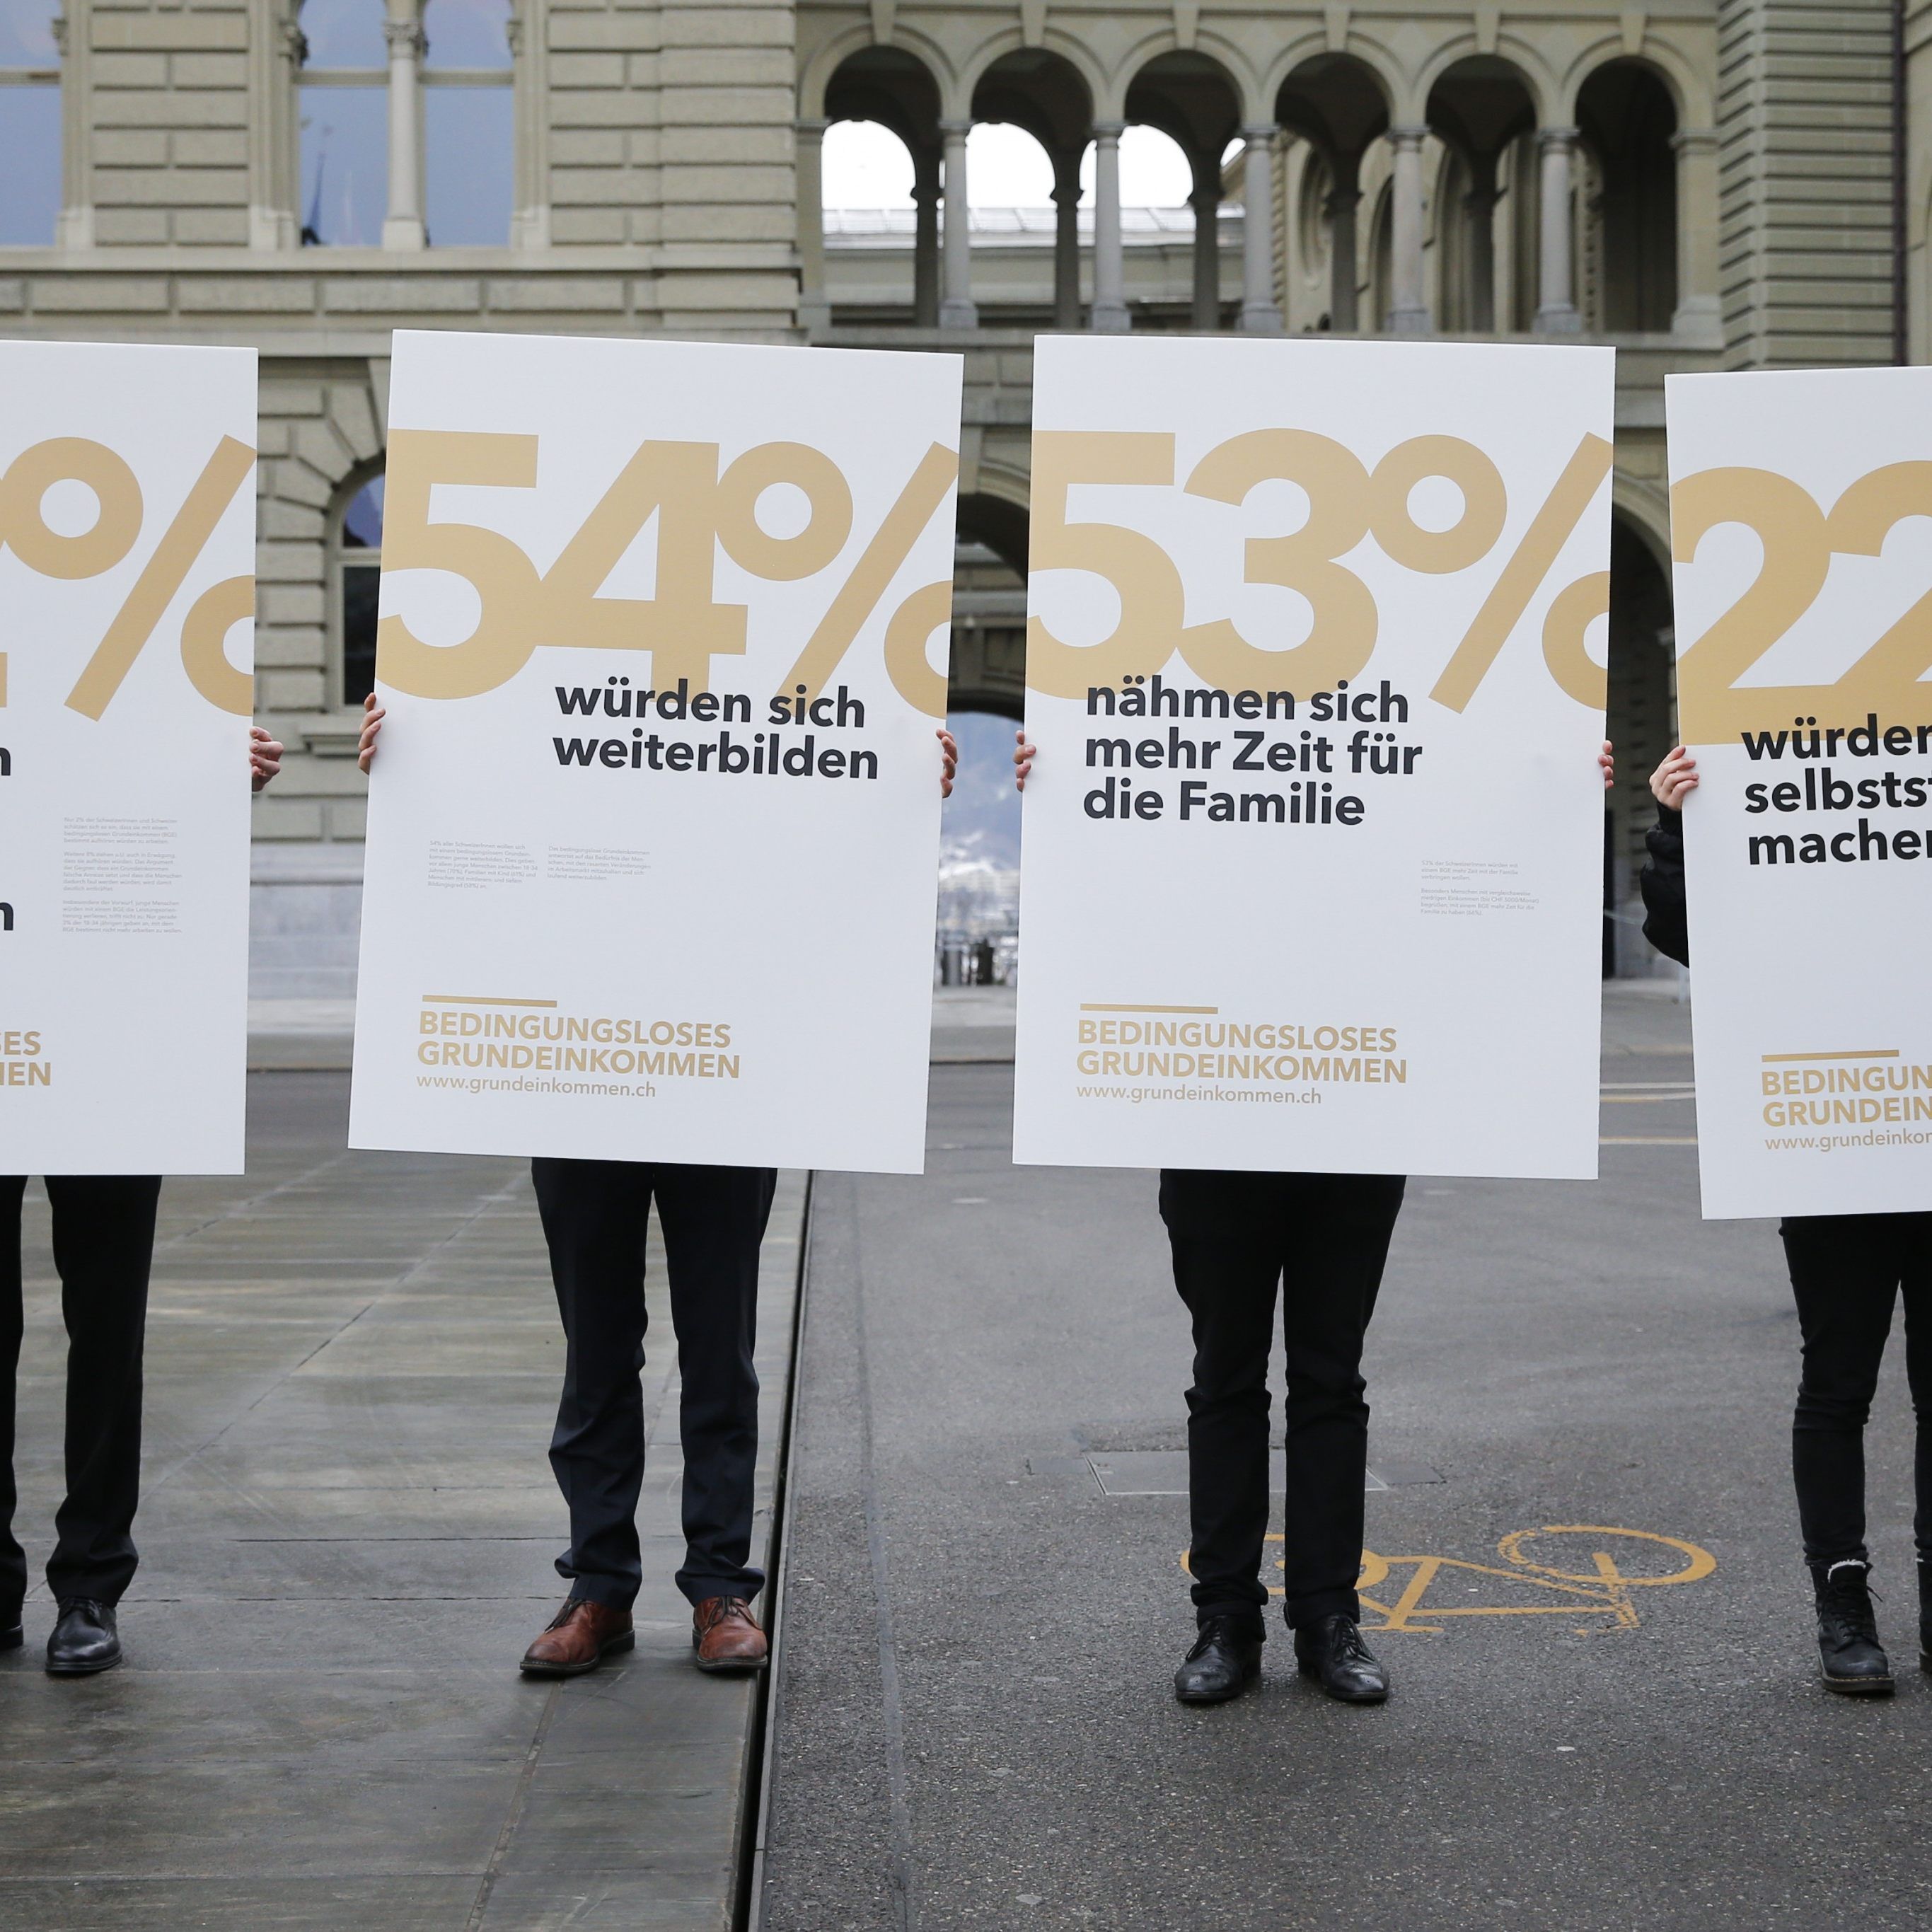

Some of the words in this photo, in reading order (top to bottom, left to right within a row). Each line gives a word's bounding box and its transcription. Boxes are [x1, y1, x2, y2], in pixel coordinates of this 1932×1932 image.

[374, 429, 960, 719] 54%
[1025, 428, 1614, 715] 53%
[555, 676, 751, 723] würden
[768, 684, 864, 728] sich
[1088, 675, 1295, 720] nähmen
[1309, 680, 1408, 722] sich
[553, 728, 877, 780] weiterbilden
[1087, 727, 1220, 769] mehr
[1233, 731, 1333, 773] Zeit
[1348, 731, 1422, 774] für
[1084, 777, 1164, 821] die
[1180, 781, 1364, 825] Familie
[1745, 768, 1932, 813] selbsts
[1749, 819, 1932, 865] mache
[0, 1031, 41, 1056] ES
[420, 1011, 731, 1048] BEDINGUNGSLOSES
[1078, 1019, 1397, 1052] BEDINGUNGSLOSES
[0, 1062, 51, 1087] EN
[417, 1041, 740, 1078] GRUNDEINKOMMEN
[1077, 1051, 1406, 1083] GRUNDEINKOMMEN
[417, 1075, 656, 1097] www.grundeinkommen.ch
[1077, 1084, 1321, 1104] www.grundeinkommen.ch
